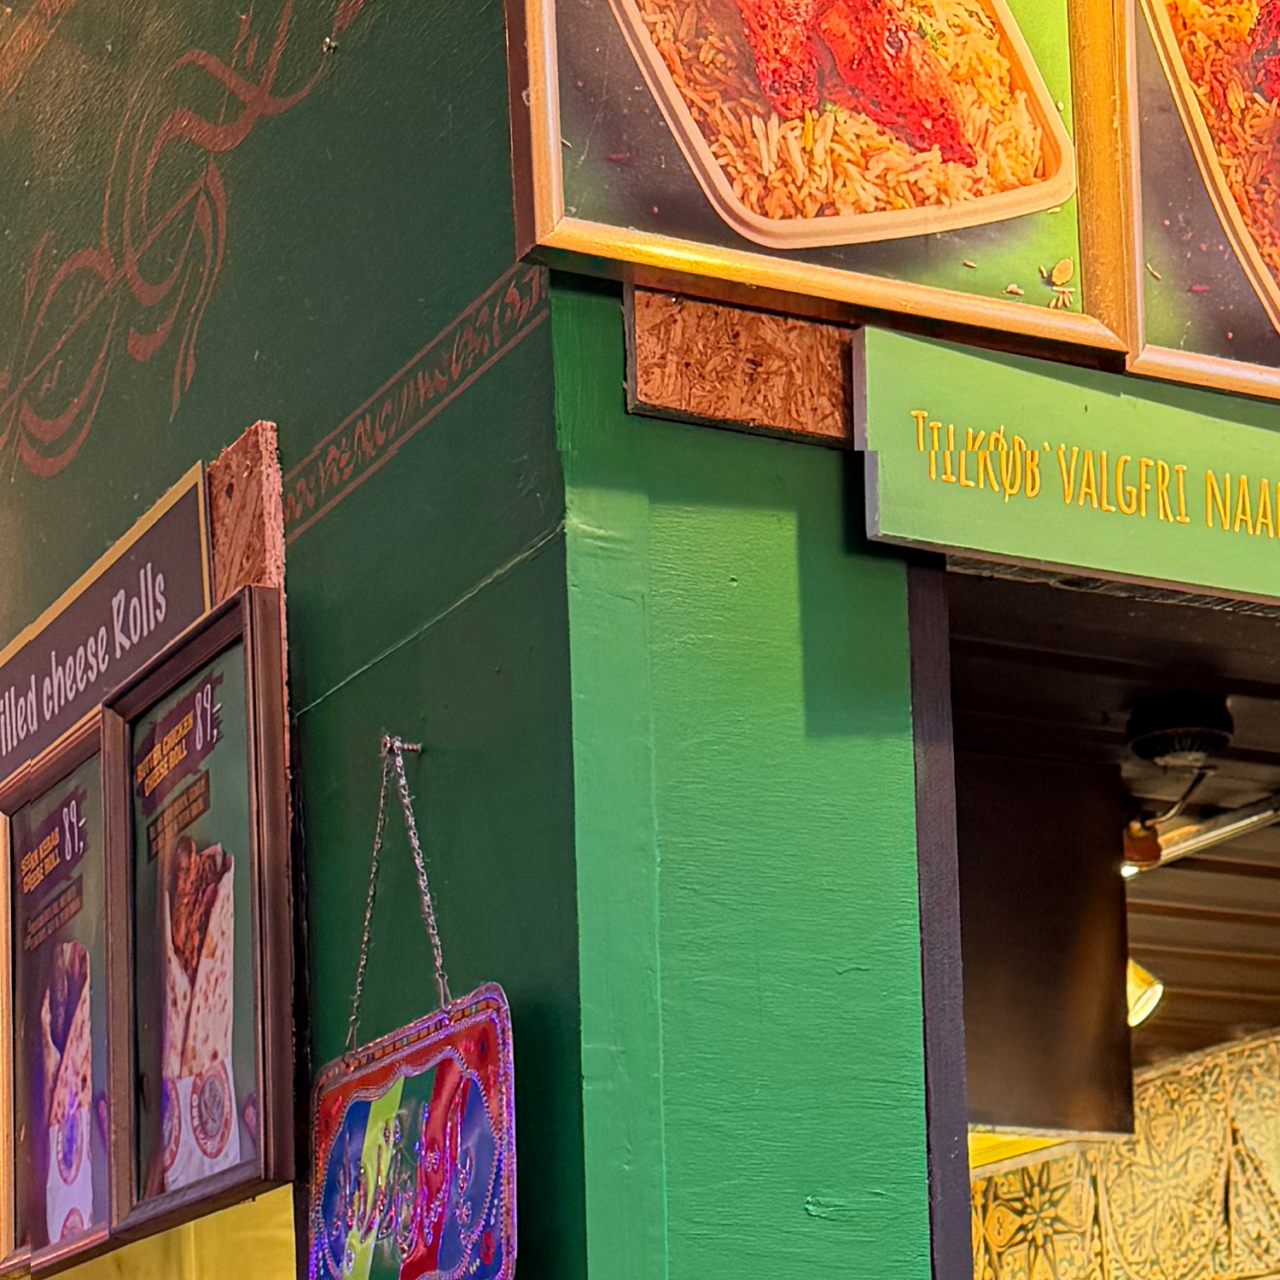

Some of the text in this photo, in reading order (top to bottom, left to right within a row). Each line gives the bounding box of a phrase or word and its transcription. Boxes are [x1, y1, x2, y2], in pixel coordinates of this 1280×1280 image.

[910, 410, 1041, 503] TILKØB
[1055, 443, 1190, 525] VALGFRI
[42, 625, 109, 722] cheese
[111, 562, 167, 660] Rolls
[168, 738, 188, 772] ROLL
